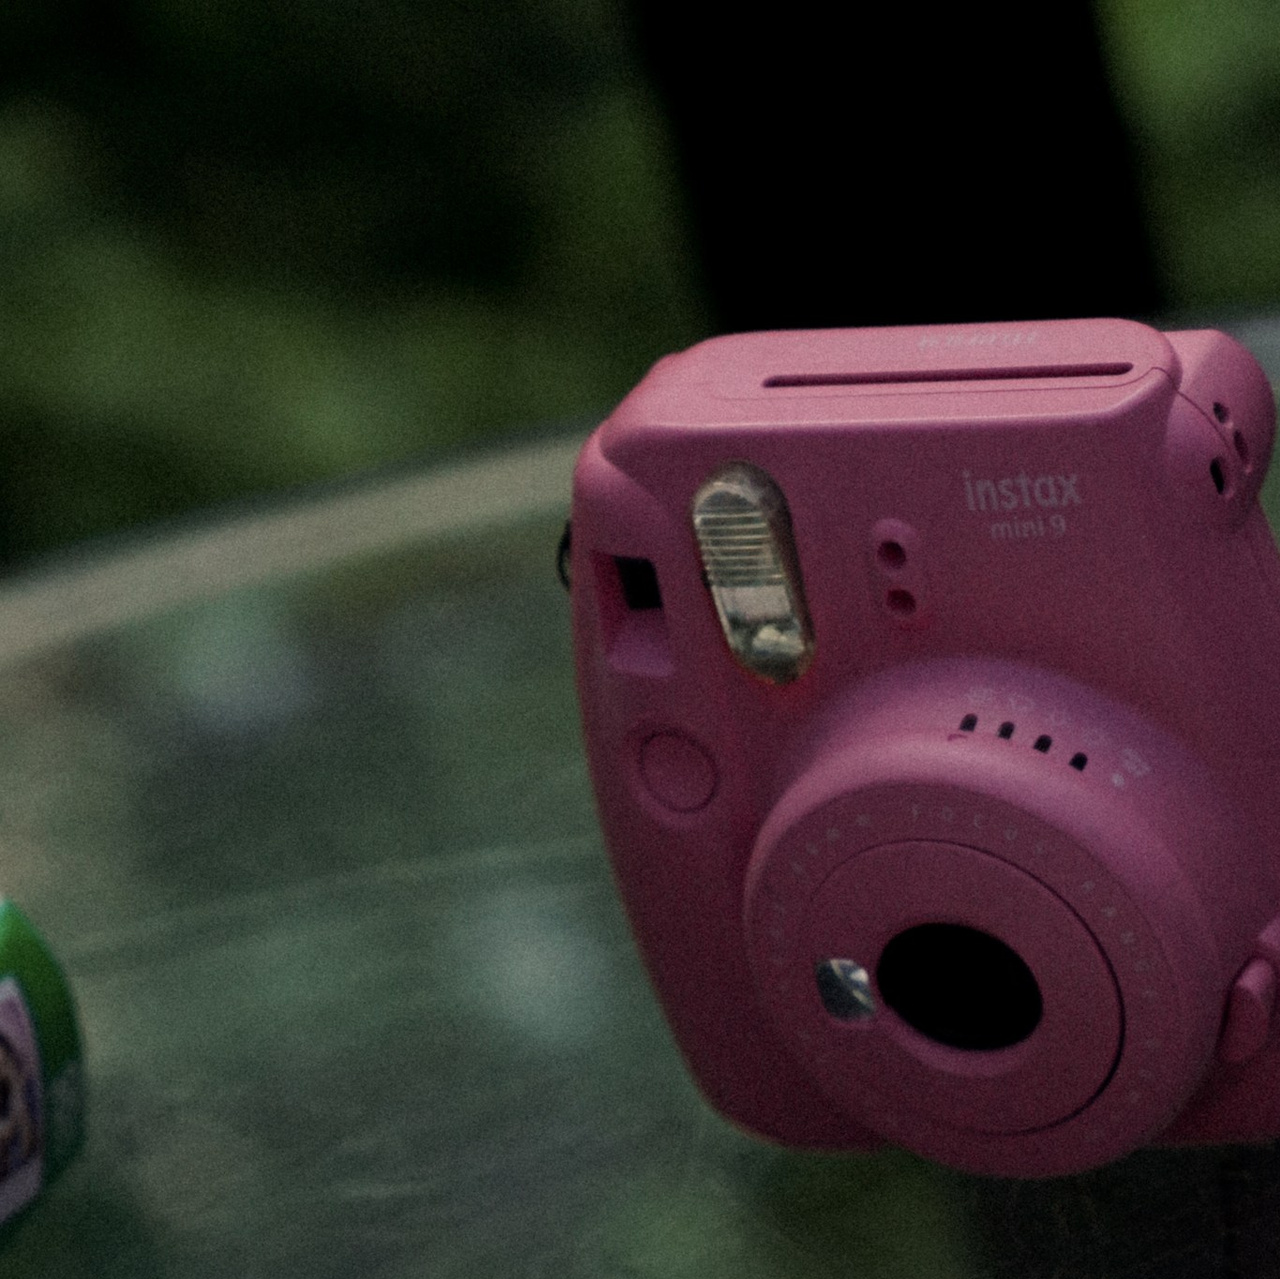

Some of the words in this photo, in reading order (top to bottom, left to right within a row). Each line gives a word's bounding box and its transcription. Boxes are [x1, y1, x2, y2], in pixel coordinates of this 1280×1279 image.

[962, 467, 1083, 511] instax
[990, 516, 1045, 540] mini
[1049, 514, 1068, 538] 9
